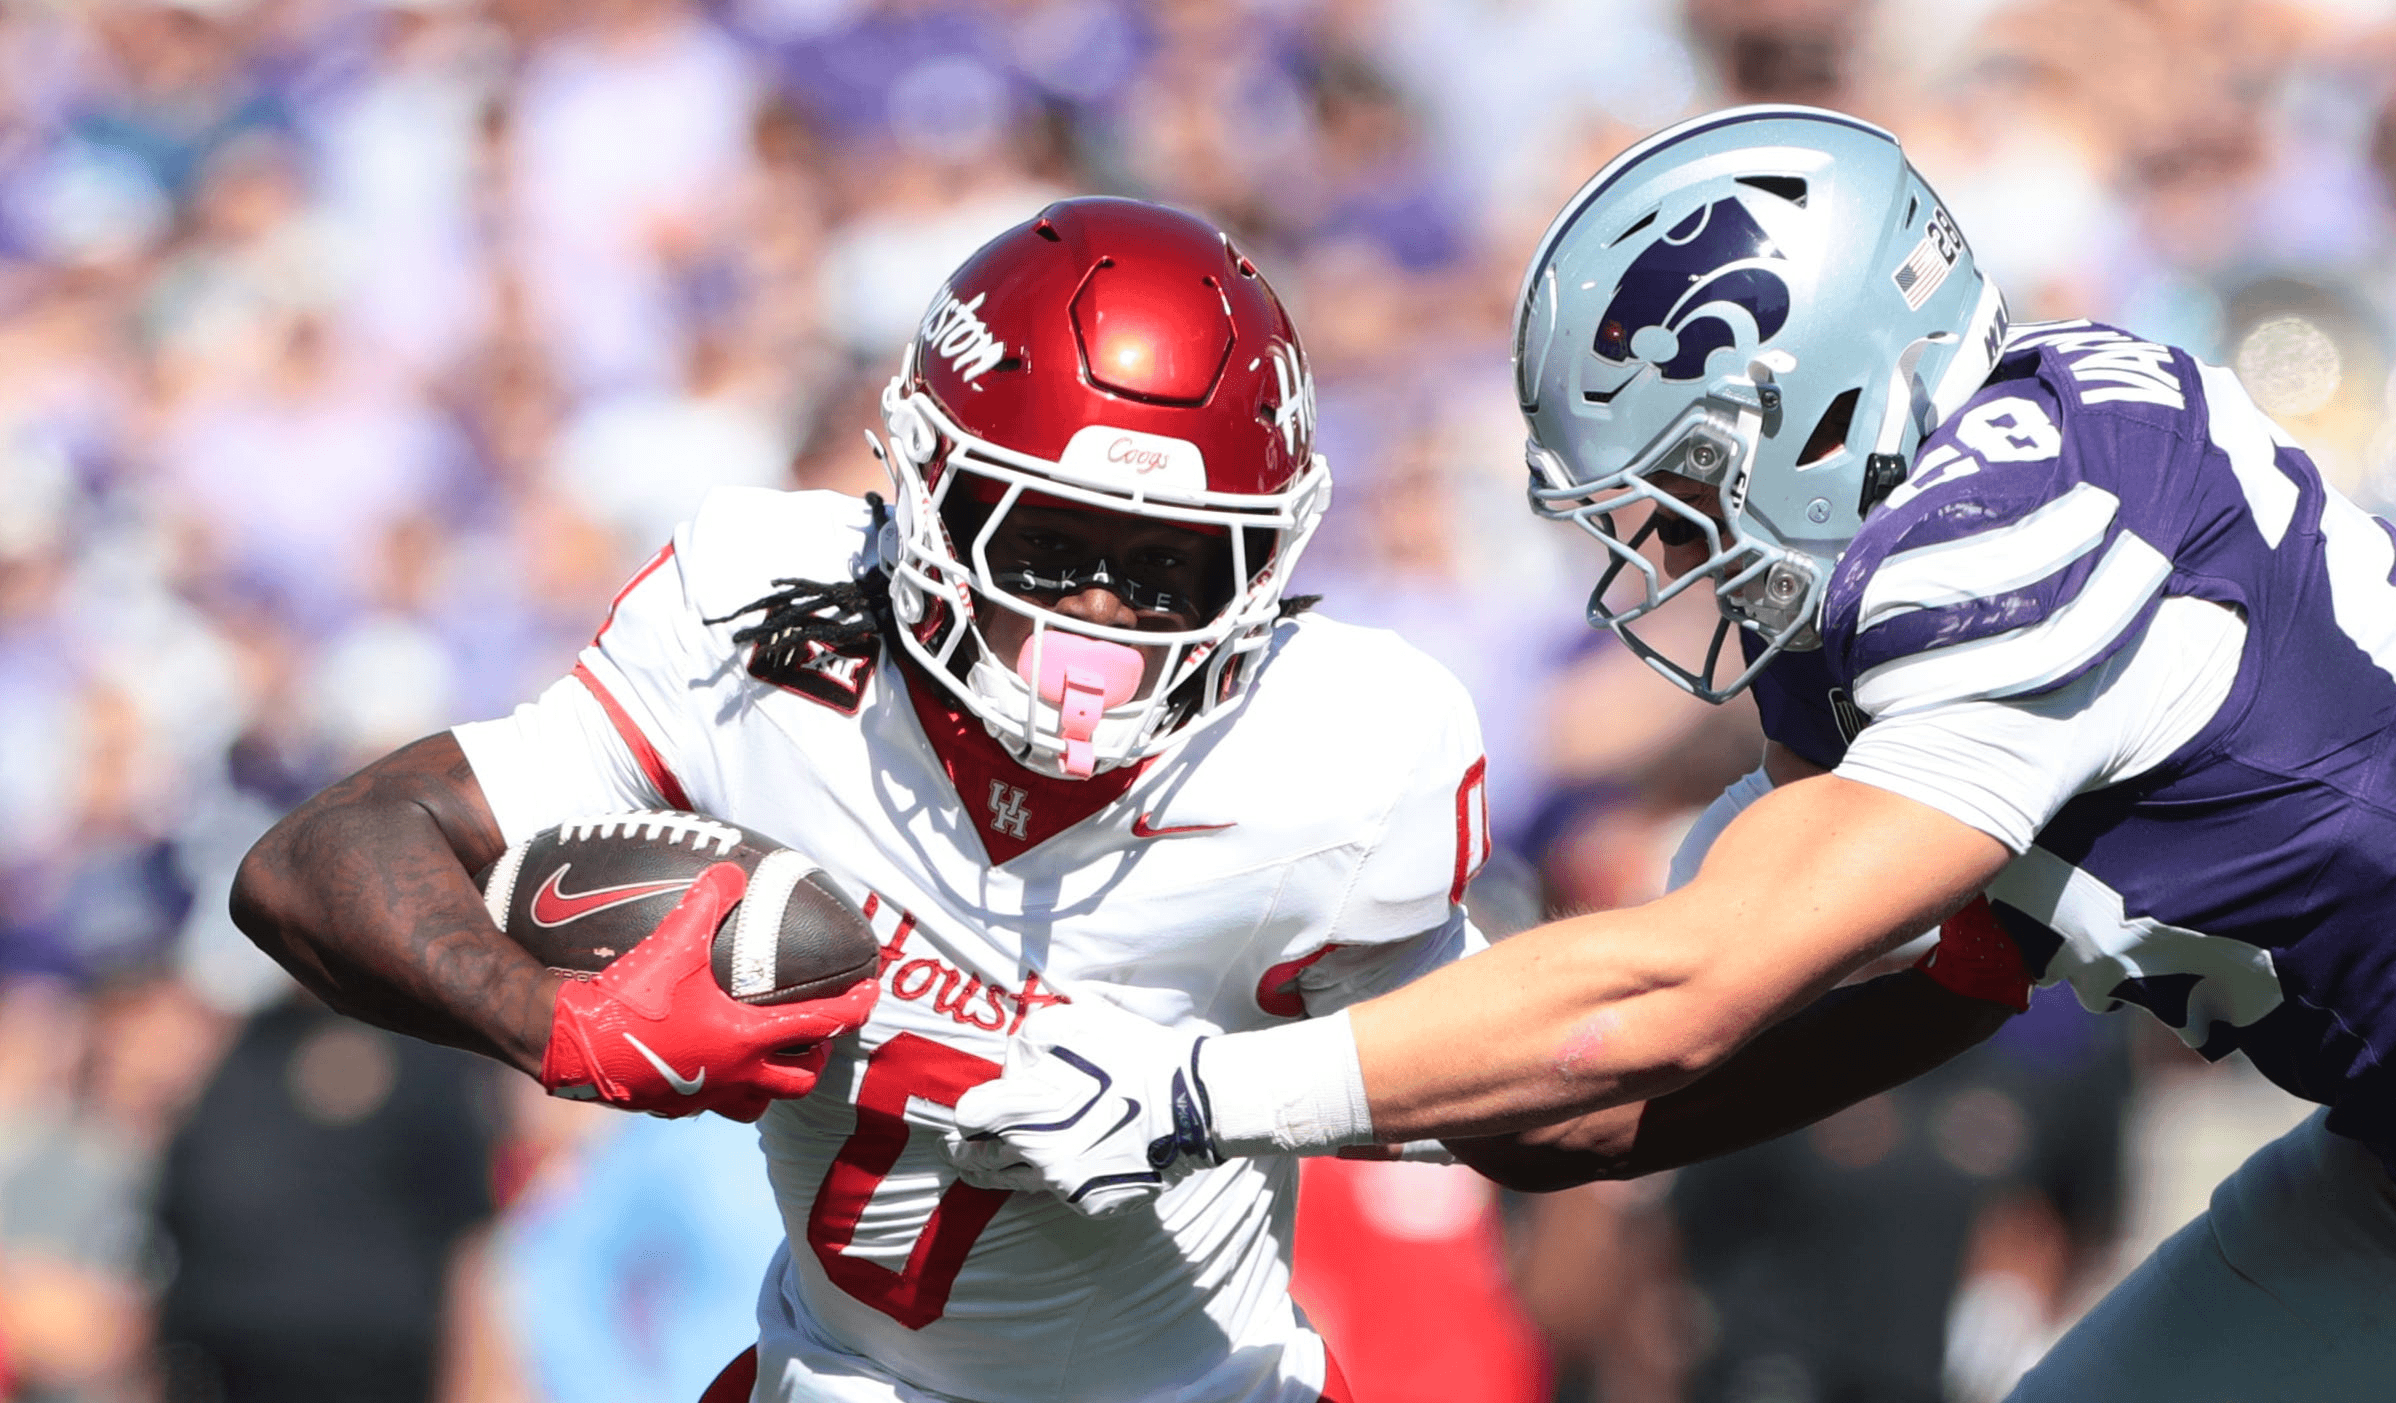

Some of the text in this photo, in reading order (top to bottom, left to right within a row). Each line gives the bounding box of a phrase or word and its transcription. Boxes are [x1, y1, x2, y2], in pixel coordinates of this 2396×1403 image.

[1926, 207, 1962, 267] 28
[1107, 436, 1170, 475] Coogs
[1020, 558, 1172, 612] SKATE
[987, 778, 1032, 841] UH
[862, 890, 1073, 1037] Houst
[807, 1031, 1014, 1331] 0
